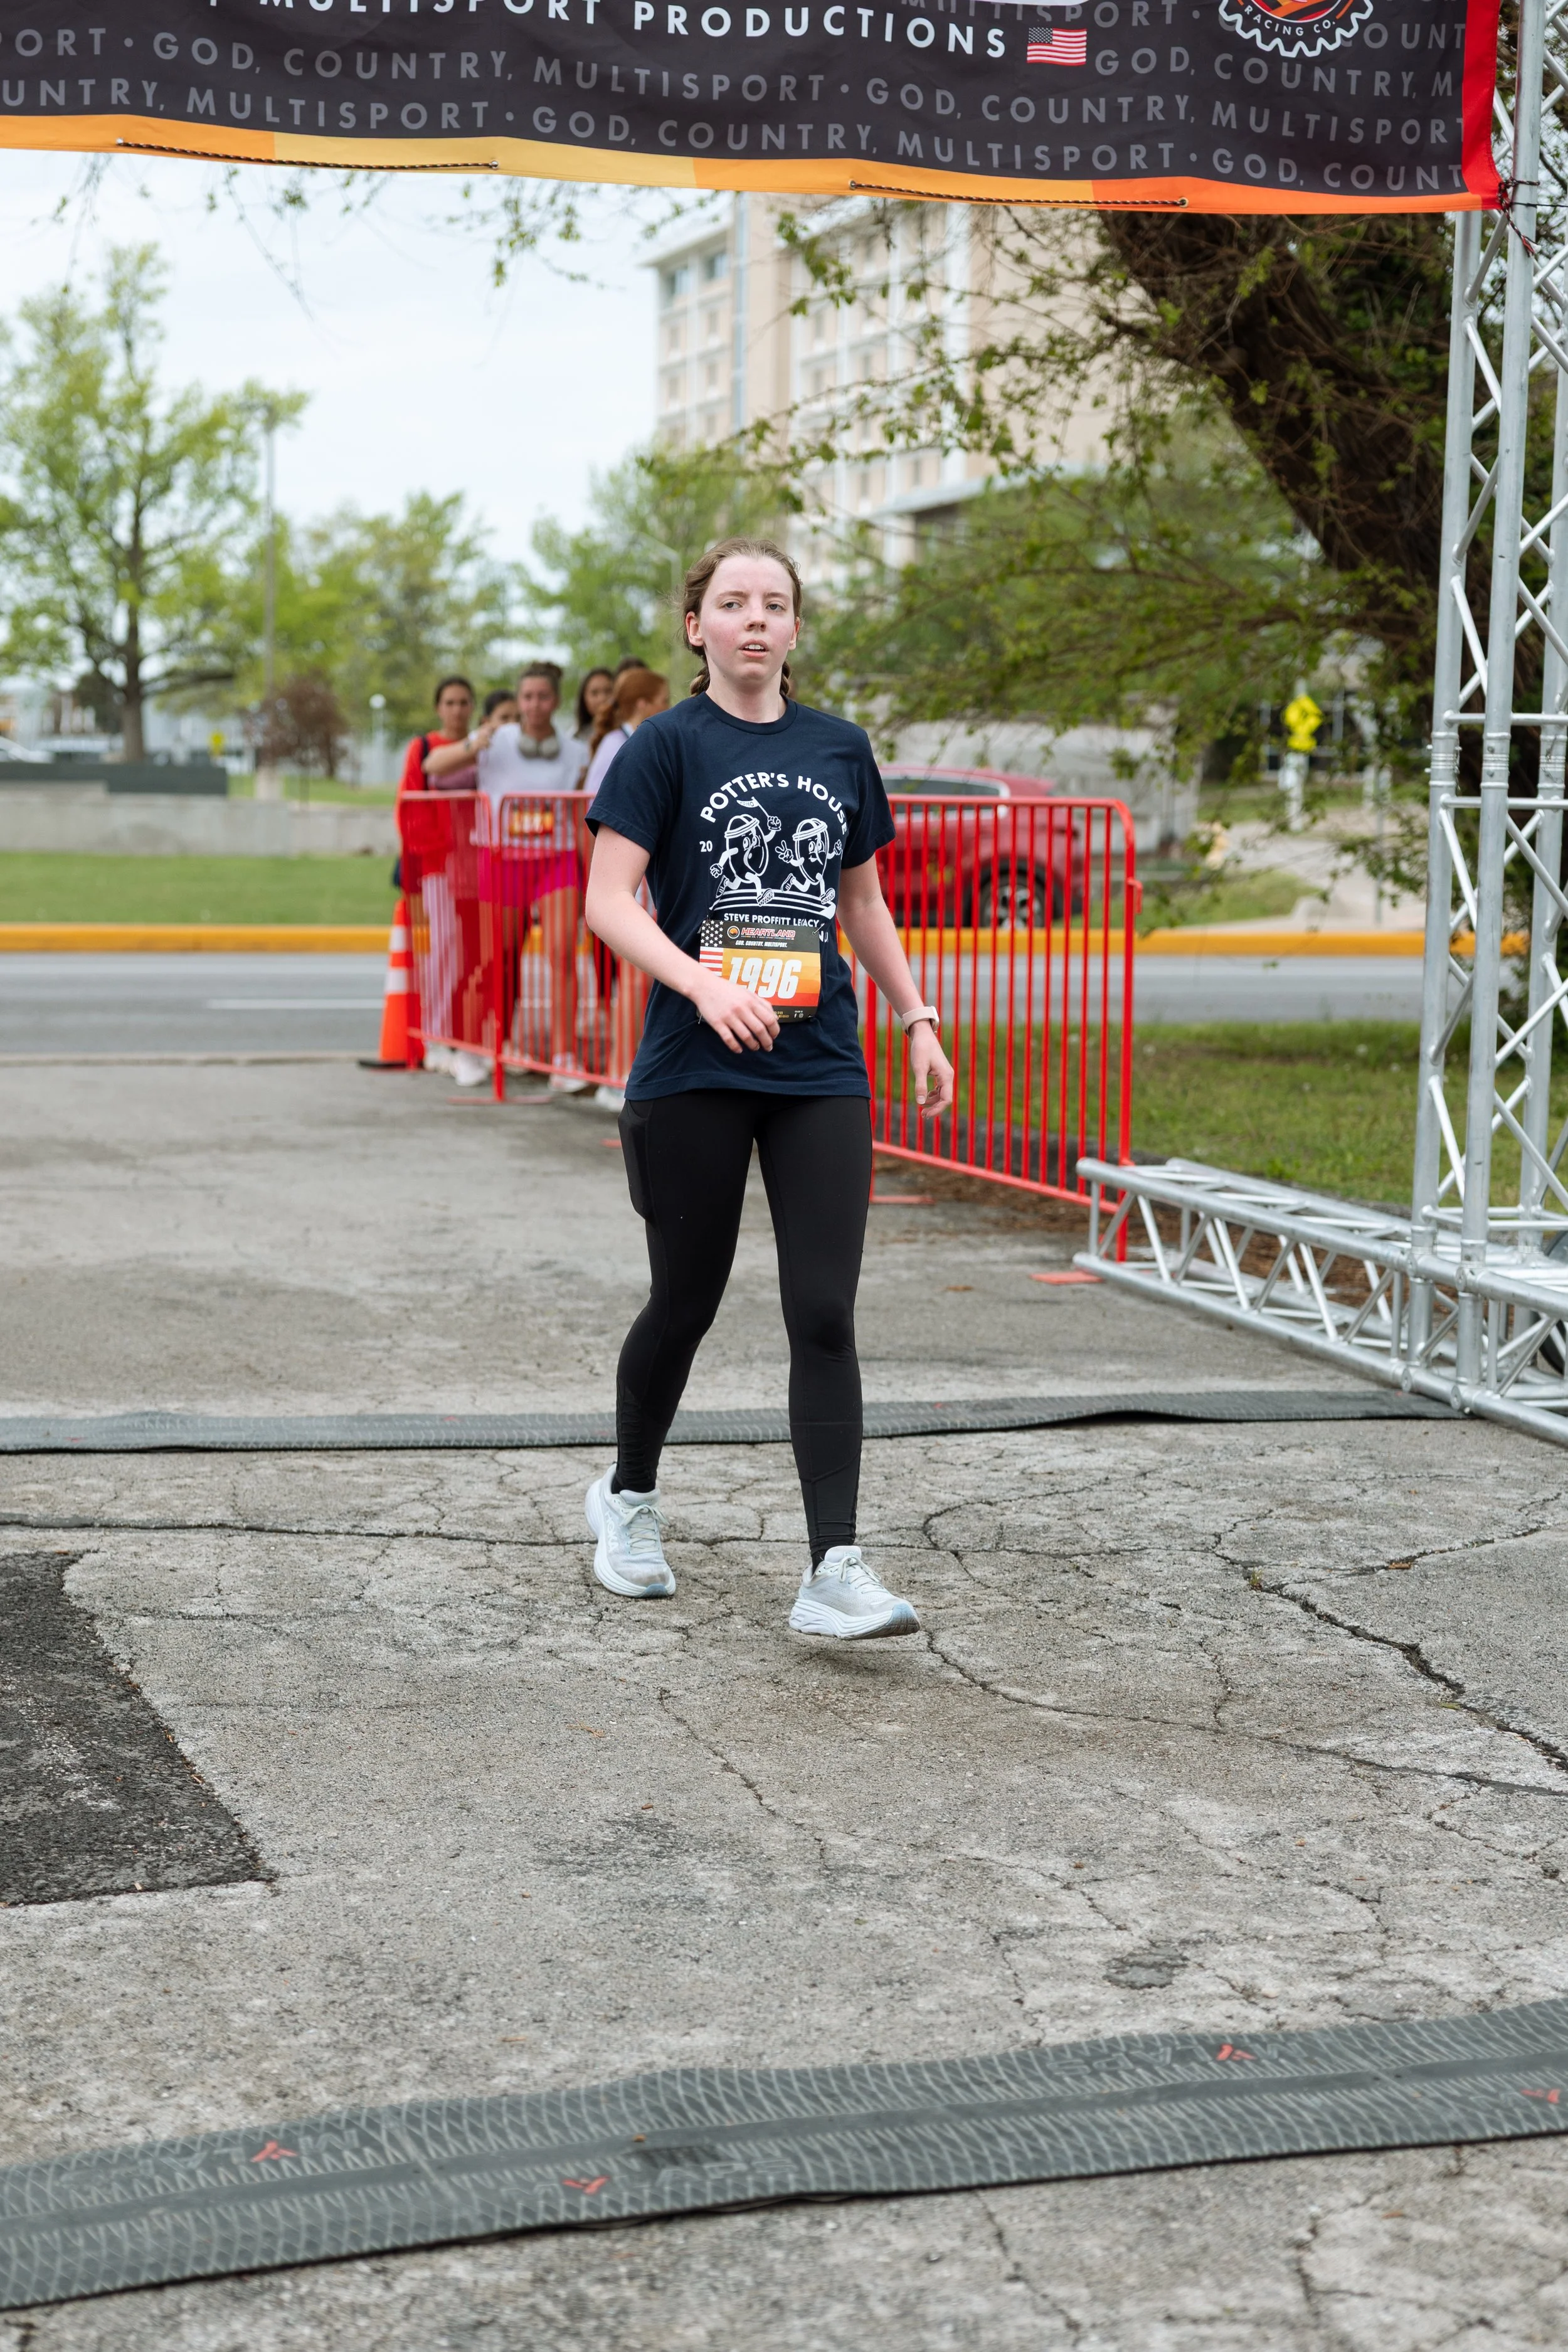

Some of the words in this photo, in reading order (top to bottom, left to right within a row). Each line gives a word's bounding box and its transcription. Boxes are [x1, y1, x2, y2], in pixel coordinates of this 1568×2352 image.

[634, 1, 1006, 58] PRODUCTIONS
[1244, 5, 1305, 37] RACING
[1313, 19, 1336, 34] CO.
[1340, 23, 1465, 49] OUNT
[0, 28, 106, 56] ORT
[154, 33, 260, 74] GOD,
[285, 49, 513, 81] COUNTRY,
[534, 57, 824, 101] MULTISPORT
[867, 78, 961, 119] GOD,
[982, 95, 1195, 124] COUNTRY,
[1095, 47, 1195, 75] GOD,
[1214, 54, 1417, 99] COUNTRY,
[2, 78, 164, 111] UNTRY,
[187, 87, 489, 129] MULTISPORT
[533, 107, 636, 146] GOD,
[659, 121, 877, 154] COUNTRY,
[898, 131, 1174, 171] MULTISPORT
[1212, 149, 1304, 187] GOD,
[1323, 162, 1461, 190] COUNT
[700, 772, 789, 823] POTTER'S
[797, 776, 847, 835] HOUSE
[699, 840, 712, 852] 20
[724, 913, 750, 923] STEVE
[752, 914, 791, 925] PROFFITT
[741, 928, 796, 938] HEARTLAND
[729, 956, 802, 999] 1996
